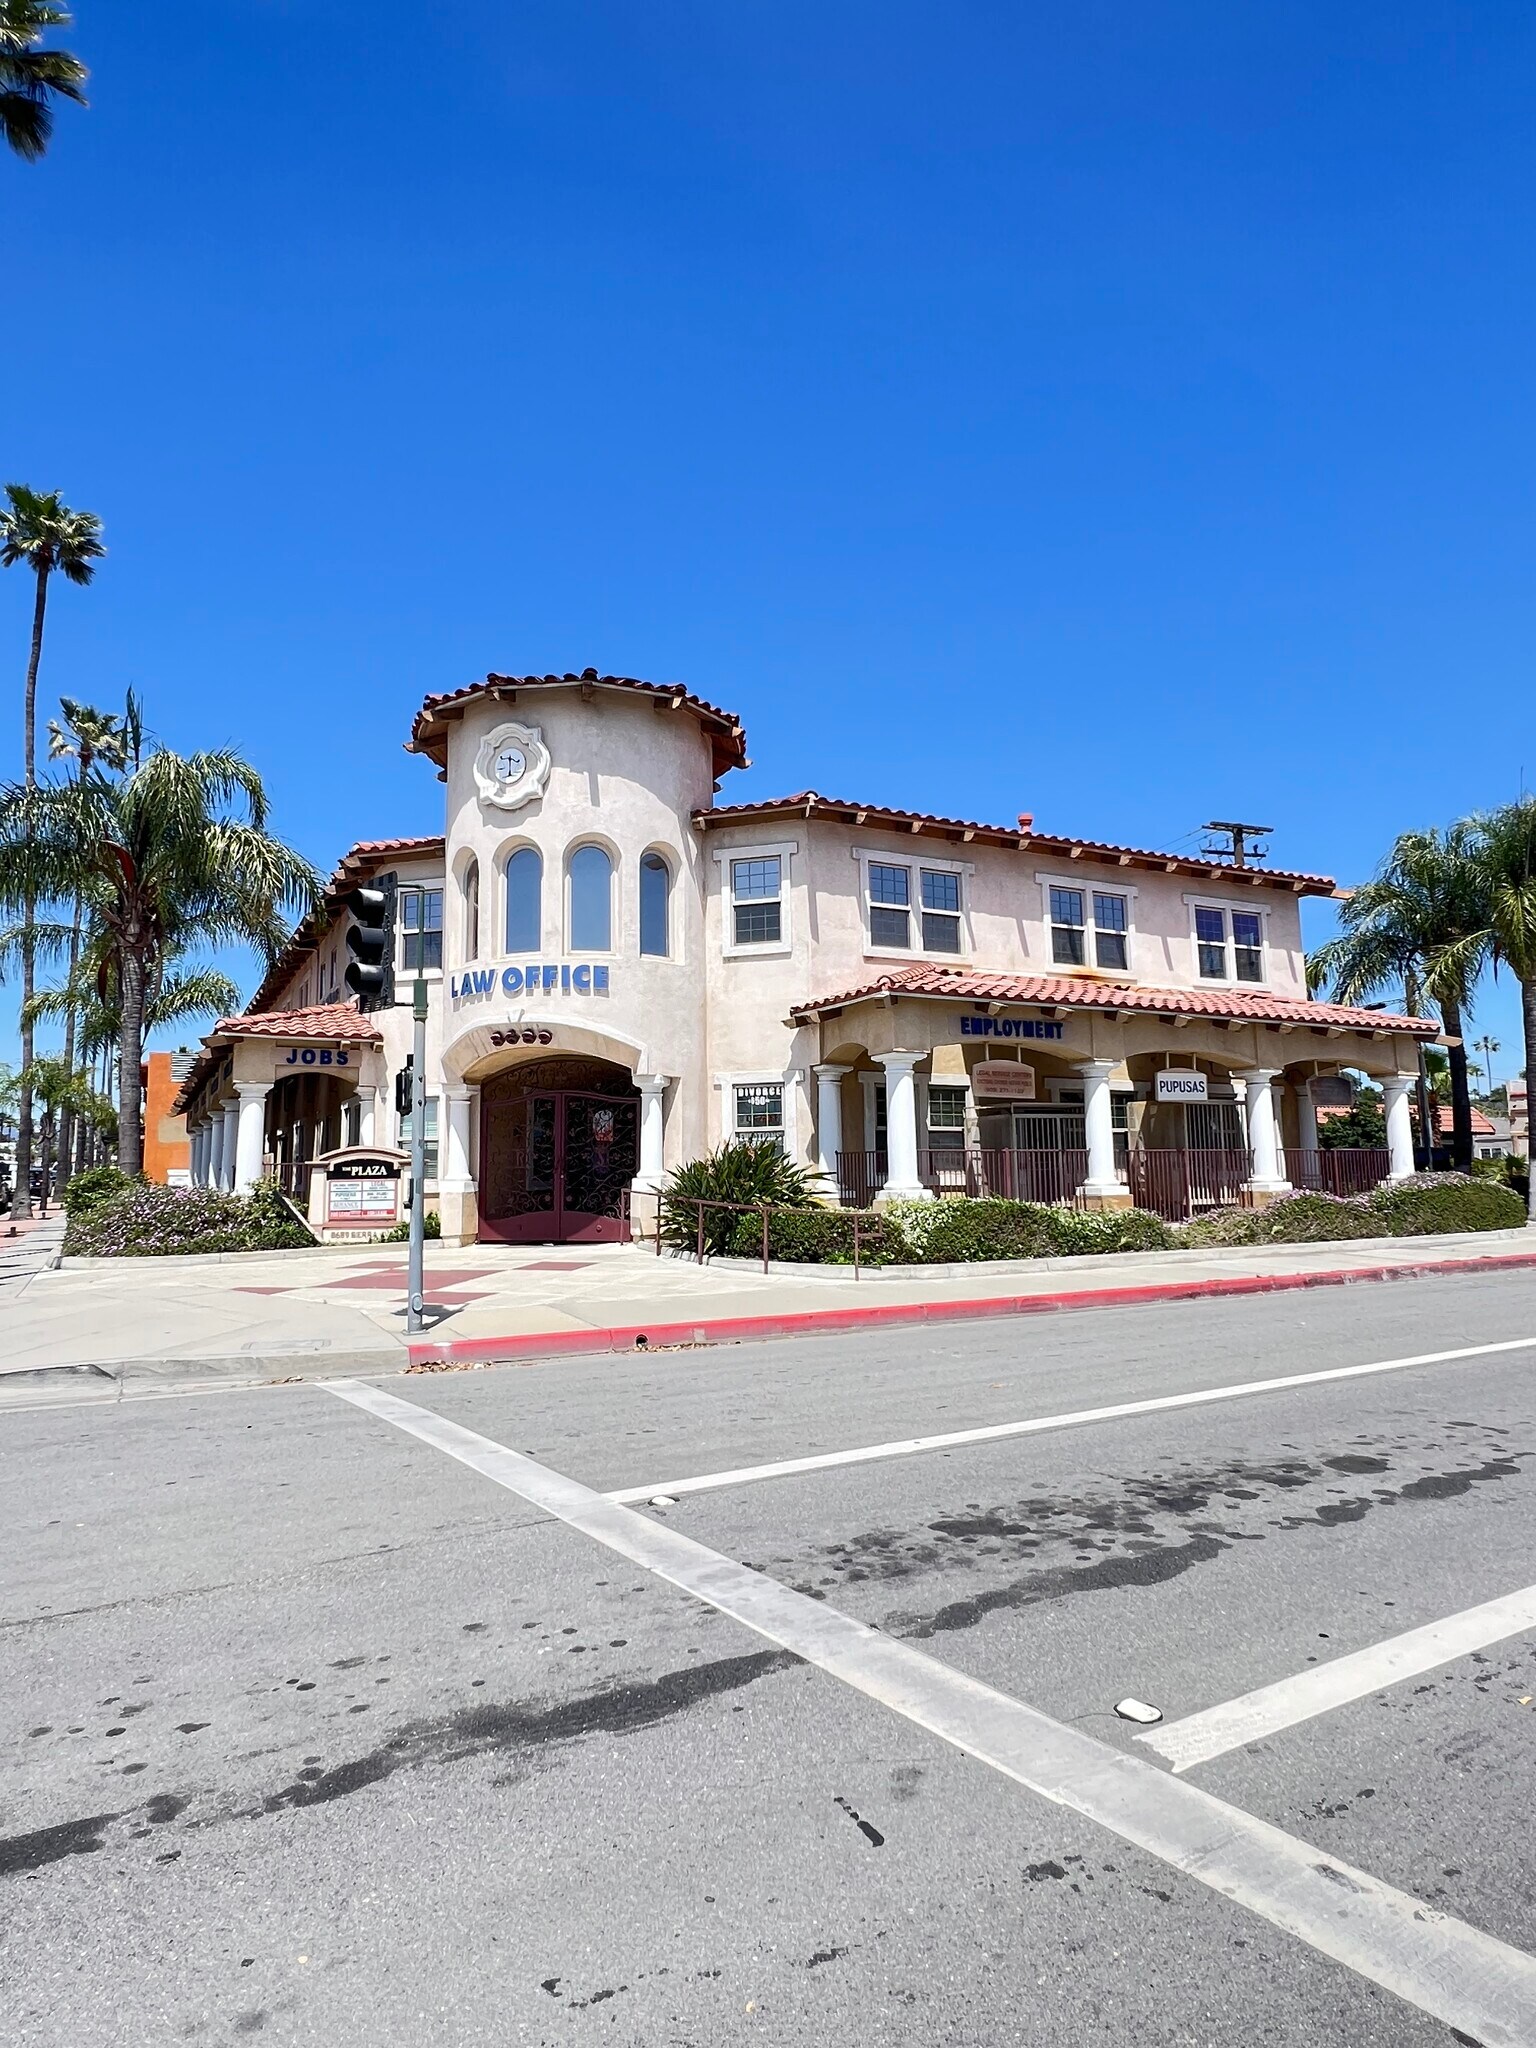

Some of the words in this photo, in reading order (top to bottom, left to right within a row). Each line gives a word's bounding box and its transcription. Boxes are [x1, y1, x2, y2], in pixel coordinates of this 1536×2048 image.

[451, 968, 496, 998] LAW
[502, 964, 609, 991] OFFICE
[960, 1016, 1064, 1039] EMPLOYMENT
[286, 1048, 349, 1065] JOBS
[738, 1086, 781, 1097] DIVORCE
[1160, 1080, 1205, 1093] PUPUSAS
[351, 1165, 388, 1176] PLAZA
